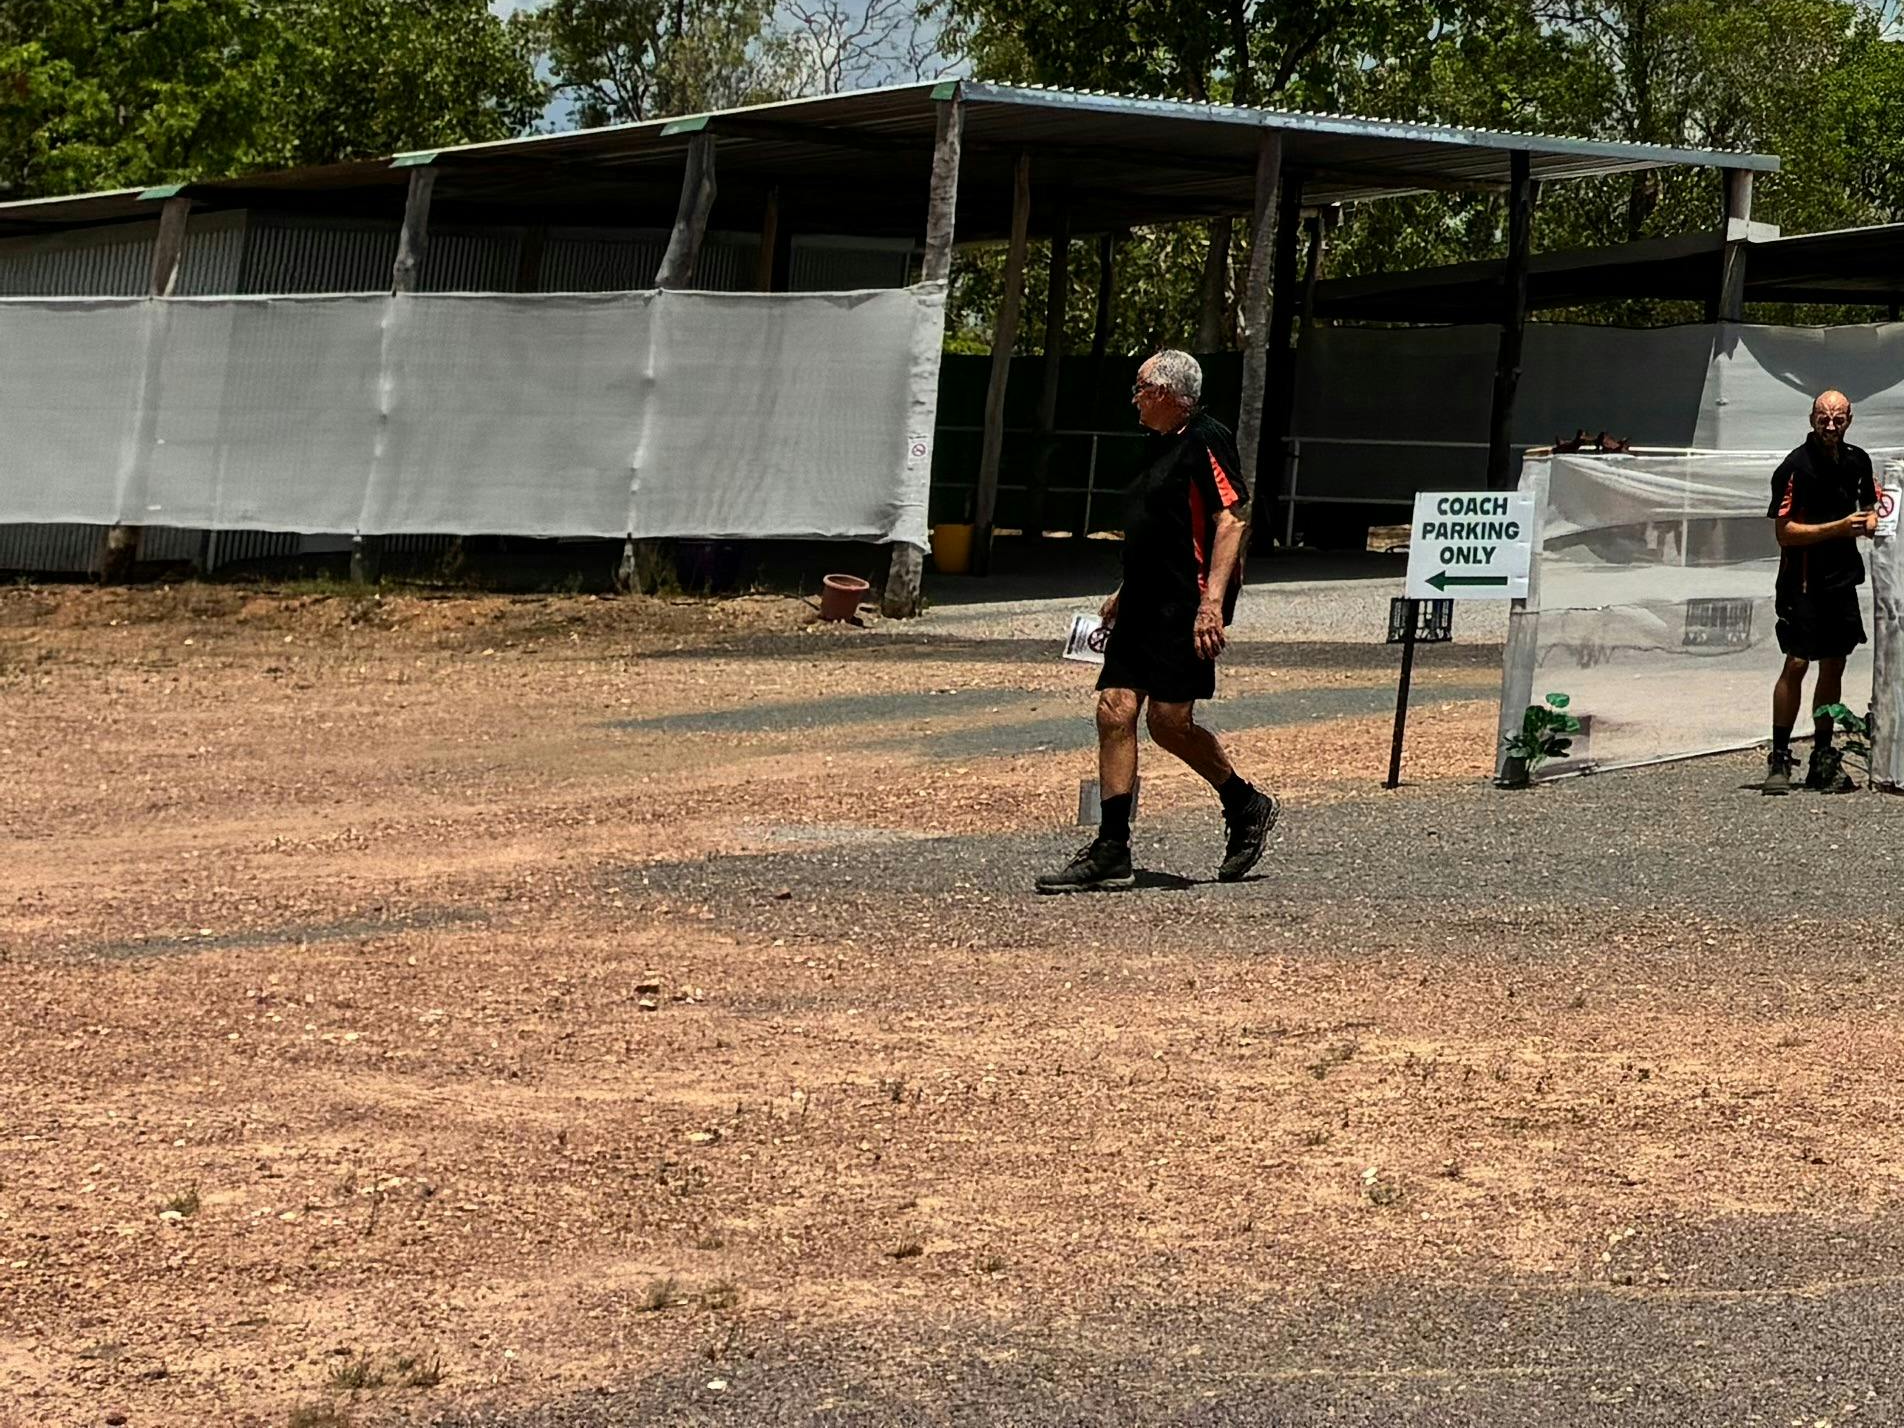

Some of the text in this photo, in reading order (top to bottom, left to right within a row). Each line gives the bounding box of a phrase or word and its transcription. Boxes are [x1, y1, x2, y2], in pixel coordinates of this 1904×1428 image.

[1437, 497, 1508, 516] COACH
[1422, 521, 1520, 540] PARKING
[1440, 546, 1497, 564] ONLY
